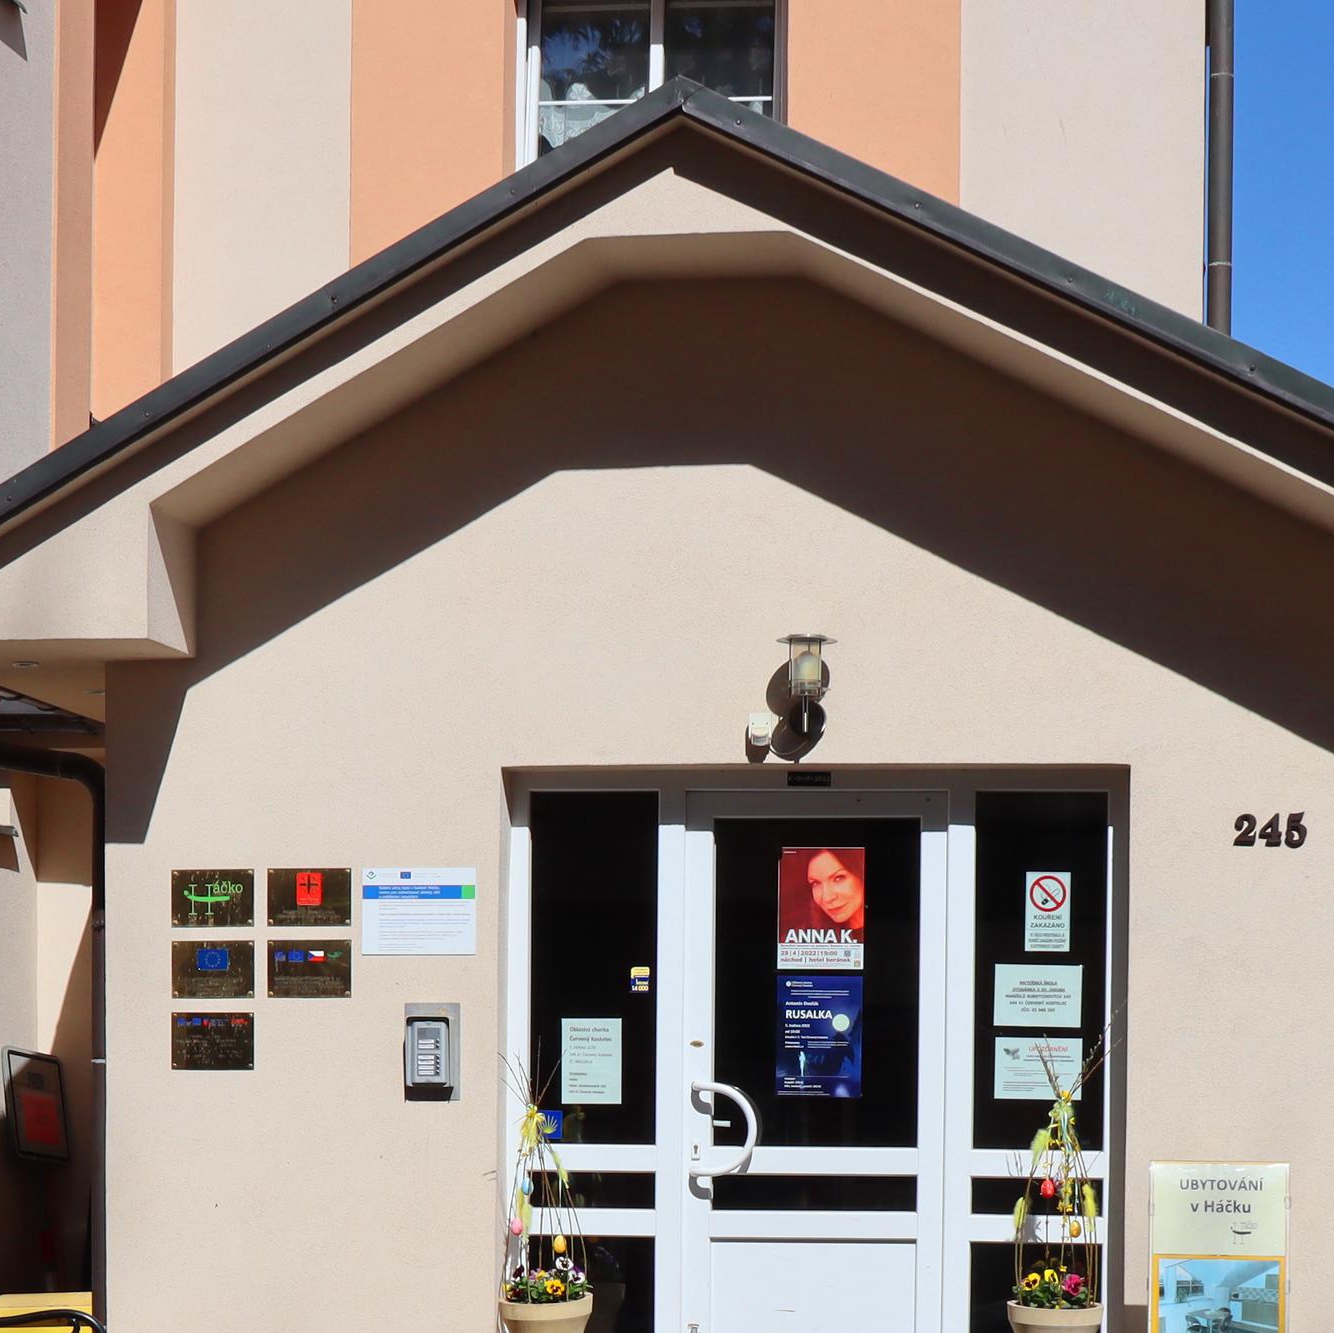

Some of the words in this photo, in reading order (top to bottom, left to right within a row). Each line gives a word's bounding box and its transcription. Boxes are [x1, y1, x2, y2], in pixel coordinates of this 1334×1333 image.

[1233, 812, 1307, 849] 245
[1030, 921, 1066, 929] ZAKÁZÁNO
[785, 929, 838, 943] ANNA
[840, 929, 857, 943] K.
[785, 1009, 833, 1019] RUSALKA
[1179, 1177, 1264, 1191] UBYTOVÁNÍ
[1190, 1202, 1200, 1212] v
[1204, 1200, 1252, 1213] Háčku
